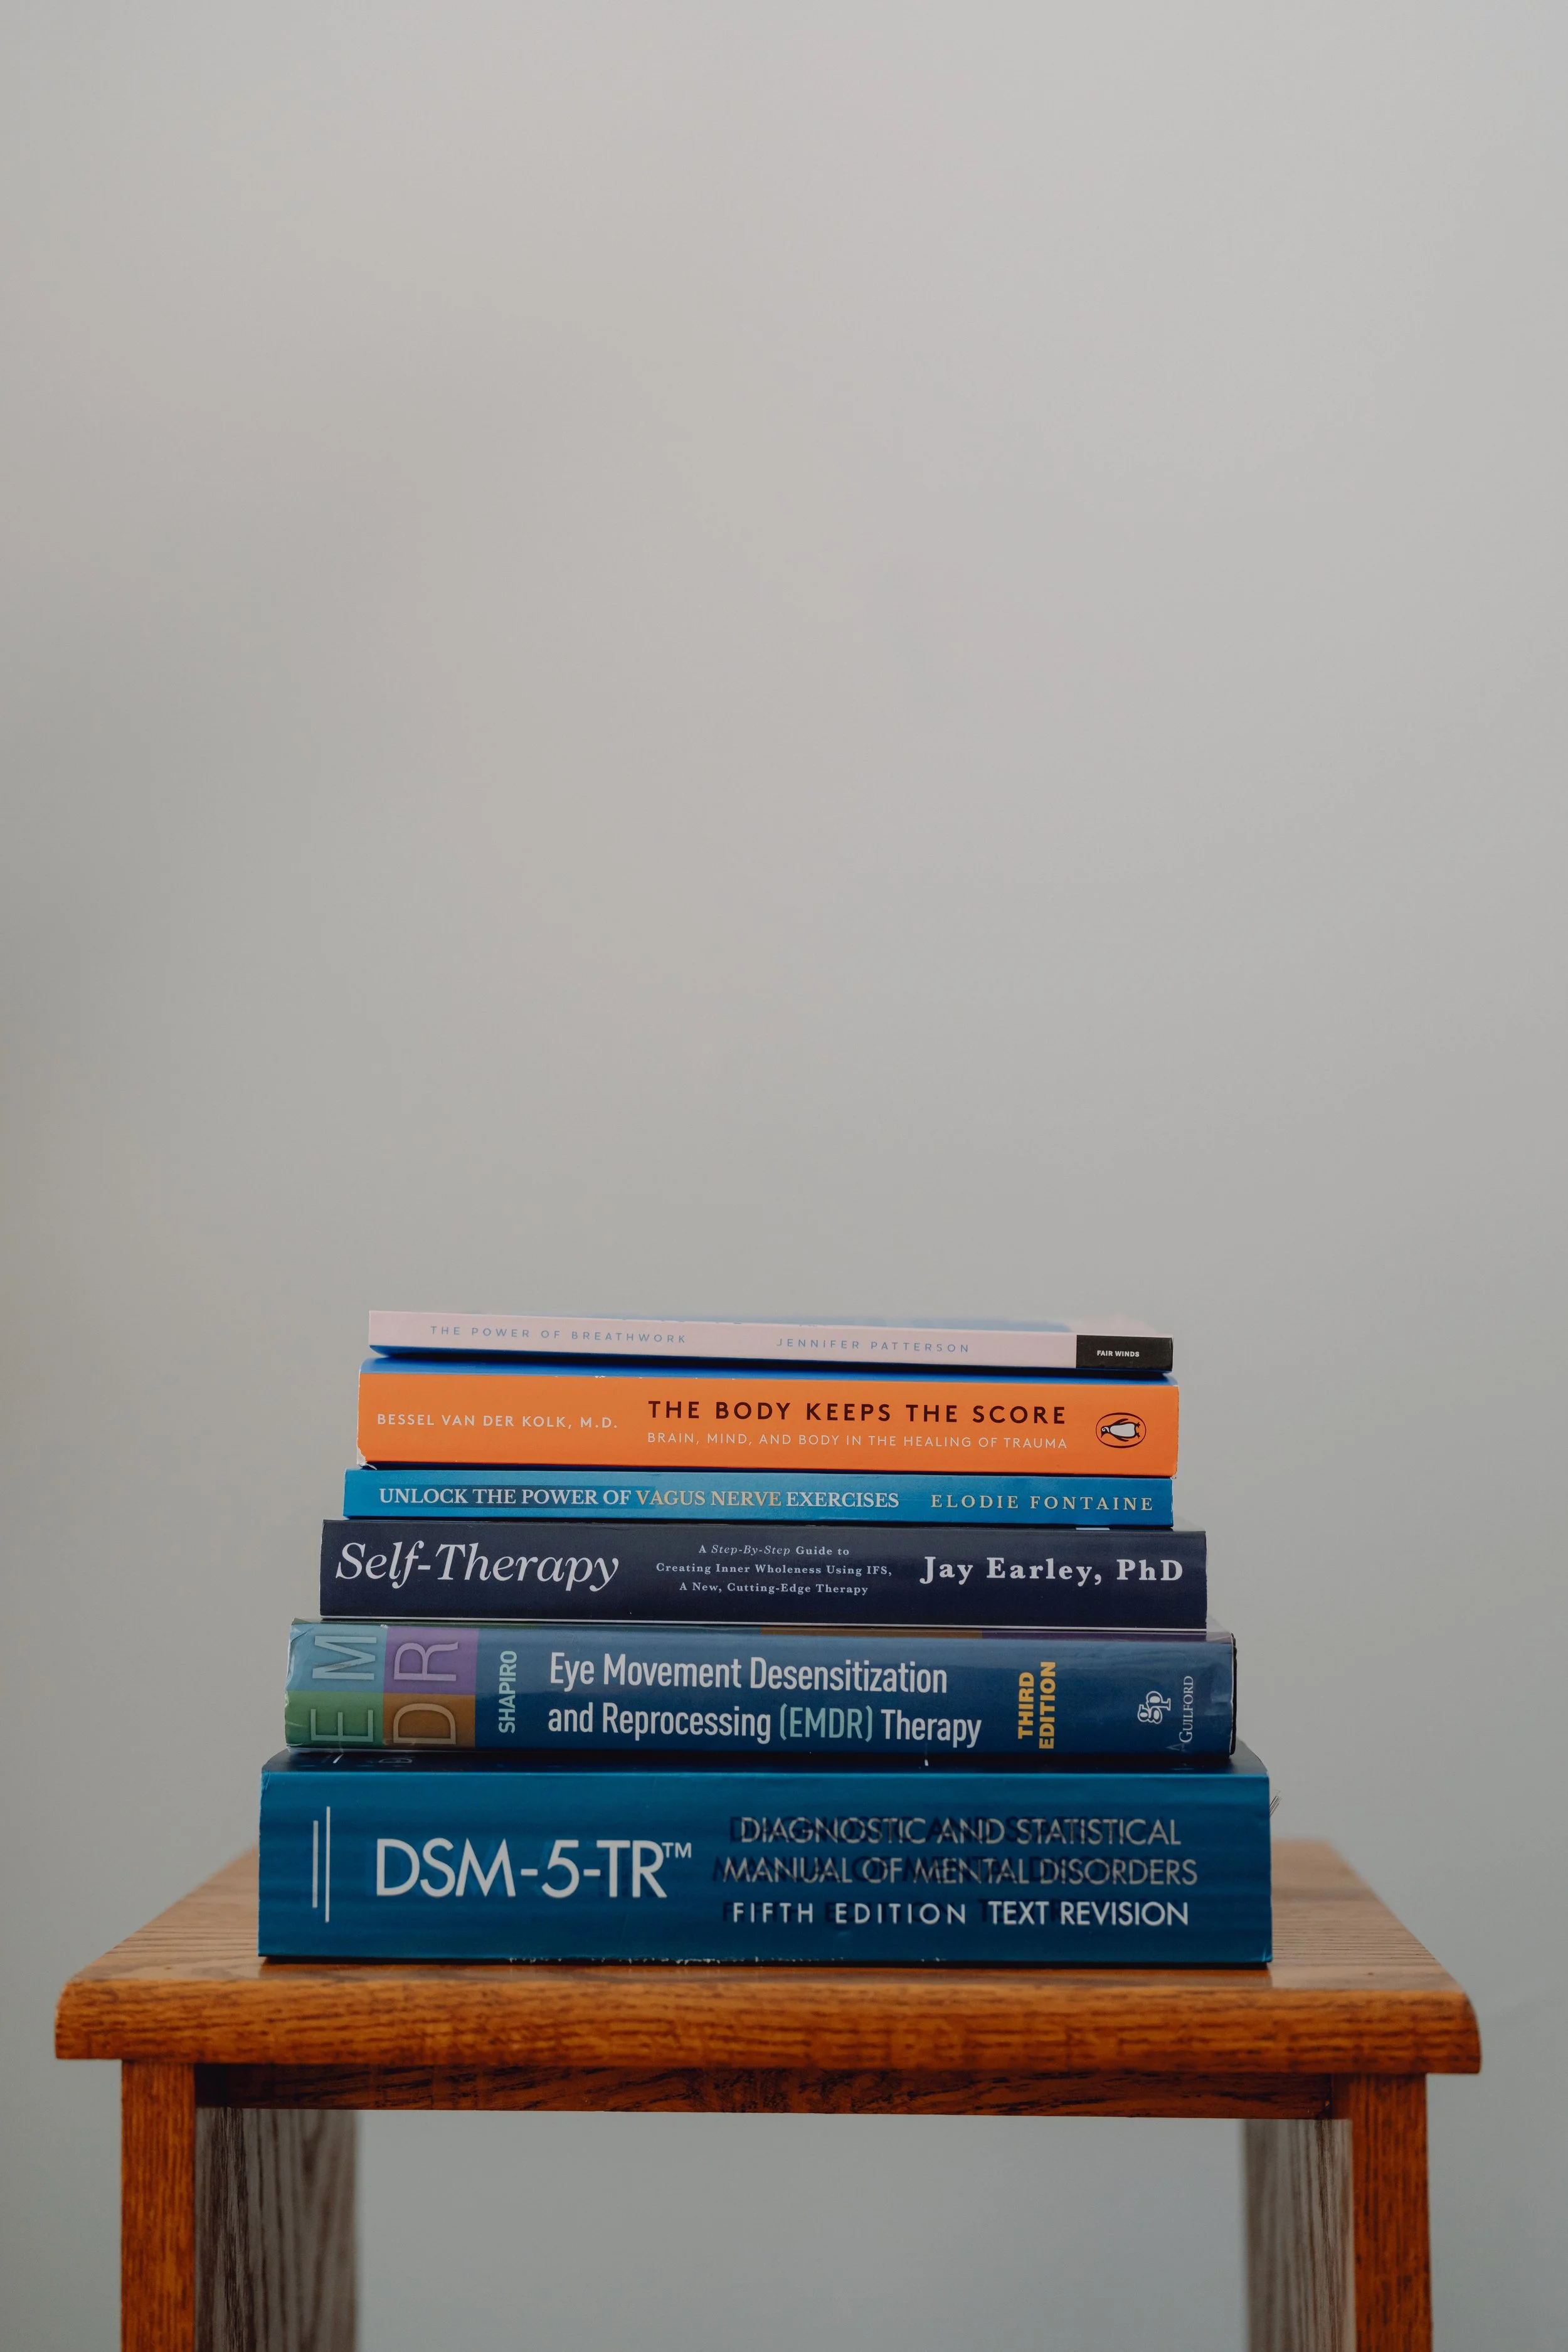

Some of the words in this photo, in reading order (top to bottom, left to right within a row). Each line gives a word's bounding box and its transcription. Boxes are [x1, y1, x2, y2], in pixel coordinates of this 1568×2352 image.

[430, 1326, 460, 1335] THE
[471, 1327, 529, 1338] POWER
[541, 1330, 560, 1339] OF
[571, 1331, 685, 1343] BREATHWORK
[776, 1338, 859, 1349] JENNIFER
[871, 1341, 968, 1353] PATTERSON
[377, 1413, 435, 1426] BESSEL
[441, 1414, 475, 1426] VAN
[483, 1415, 514, 1427] DER
[522, 1416, 572, 1429] KOLK,
[580, 1417, 617, 1428] M.D.
[648, 1401, 699, 1419] THE
[716, 1401, 791, 1420] BODY
[807, 1402, 891, 1422] KEEPS
[905, 1404, 957, 1422] THE
[972, 1405, 1065, 1424] SCORE
[647, 1432, 699, 1445] BRAIN,
[707, 1433, 751, 1446] MIND,
[759, 1434, 792, 1445] AND
[798, 1434, 839, 1446] BODY
[846, 1434, 861, 1446] IN
[868, 1435, 896, 1446] THE
[904, 1436, 971, 1448] HEALING
[978, 1437, 998, 1448] OF
[1003, 1437, 1067, 1449] TRAUMA
[379, 1488, 469, 1504] UNLOCK
[472, 1488, 516, 1504] THE
[521, 1489, 599, 1505] POWER
[603, 1490, 632, 1505] OF
[635, 1490, 706, 1506] VAGUS
[710, 1490, 781, 1507] NERVE
[786, 1491, 899, 1508] EXERCISES
[931, 1494, 1019, 1509] ELODIE
[1030, 1495, 1153, 1511] FONTAINE
[698, 1544, 707, 1554] A
[711, 1544, 790, 1557] Step-By-Step
[795, 1545, 833, 1555] Guide
[335, 1540, 619, 1592] Self-Therapy
[656, 1562, 711, 1575] Creating
[716, 1564, 750, 1573] Inner
[755, 1564, 822, 1574] Wholeness
[826, 1565, 862, 1577] Using
[866, 1565, 892, 1577] IFS,
[919, 1556, 973, 1586] Jay
[986, 1557, 1102, 1587] Earley,
[1116, 1559, 1183, 1581] PhD
[679, 1582, 688, 1591] A
[692, 1582, 722, 1593] New,
[727, 1582, 811, 1595] Cutting-Edge
[815, 1584, 868, 1596] Therapy
[550, 1651, 595, 1692] Eye
[603, 1653, 742, 1688] Movement
[750, 1656, 947, 1693] Desensitization
[498, 1650, 517, 1734] SHAPIRO
[1017, 1671, 1034, 1739] THIRD
[1039, 1661, 1056, 1749] EDITION
[1179, 1675, 1194, 1743] GUILFORD
[548, 1702, 593, 1733] and
[603, 1702, 771, 1744] Reprocessing
[780, 1702, 873, 1742] (EMDR)
[880, 1708, 982, 1749] Therapy
[741, 1816, 926, 1845] DIAGNOSTIC
[936, 1818, 1005, 1845] AND
[1016, 1818, 1182, 1846] STATISTICAL
[723, 1857, 853, 1883] MANUAL
[862, 1857, 903, 1884] OF
[913, 1858, 1030, 1885] MENTAL
[1039, 1858, 1198, 1886] DISORDERS
[733, 1902, 813, 1924] FIFTH
[835, 1903, 966, 1925] EDITION
[987, 1900, 1049, 1925] TEXT
[1061, 1901, 1189, 1926] REVISION
